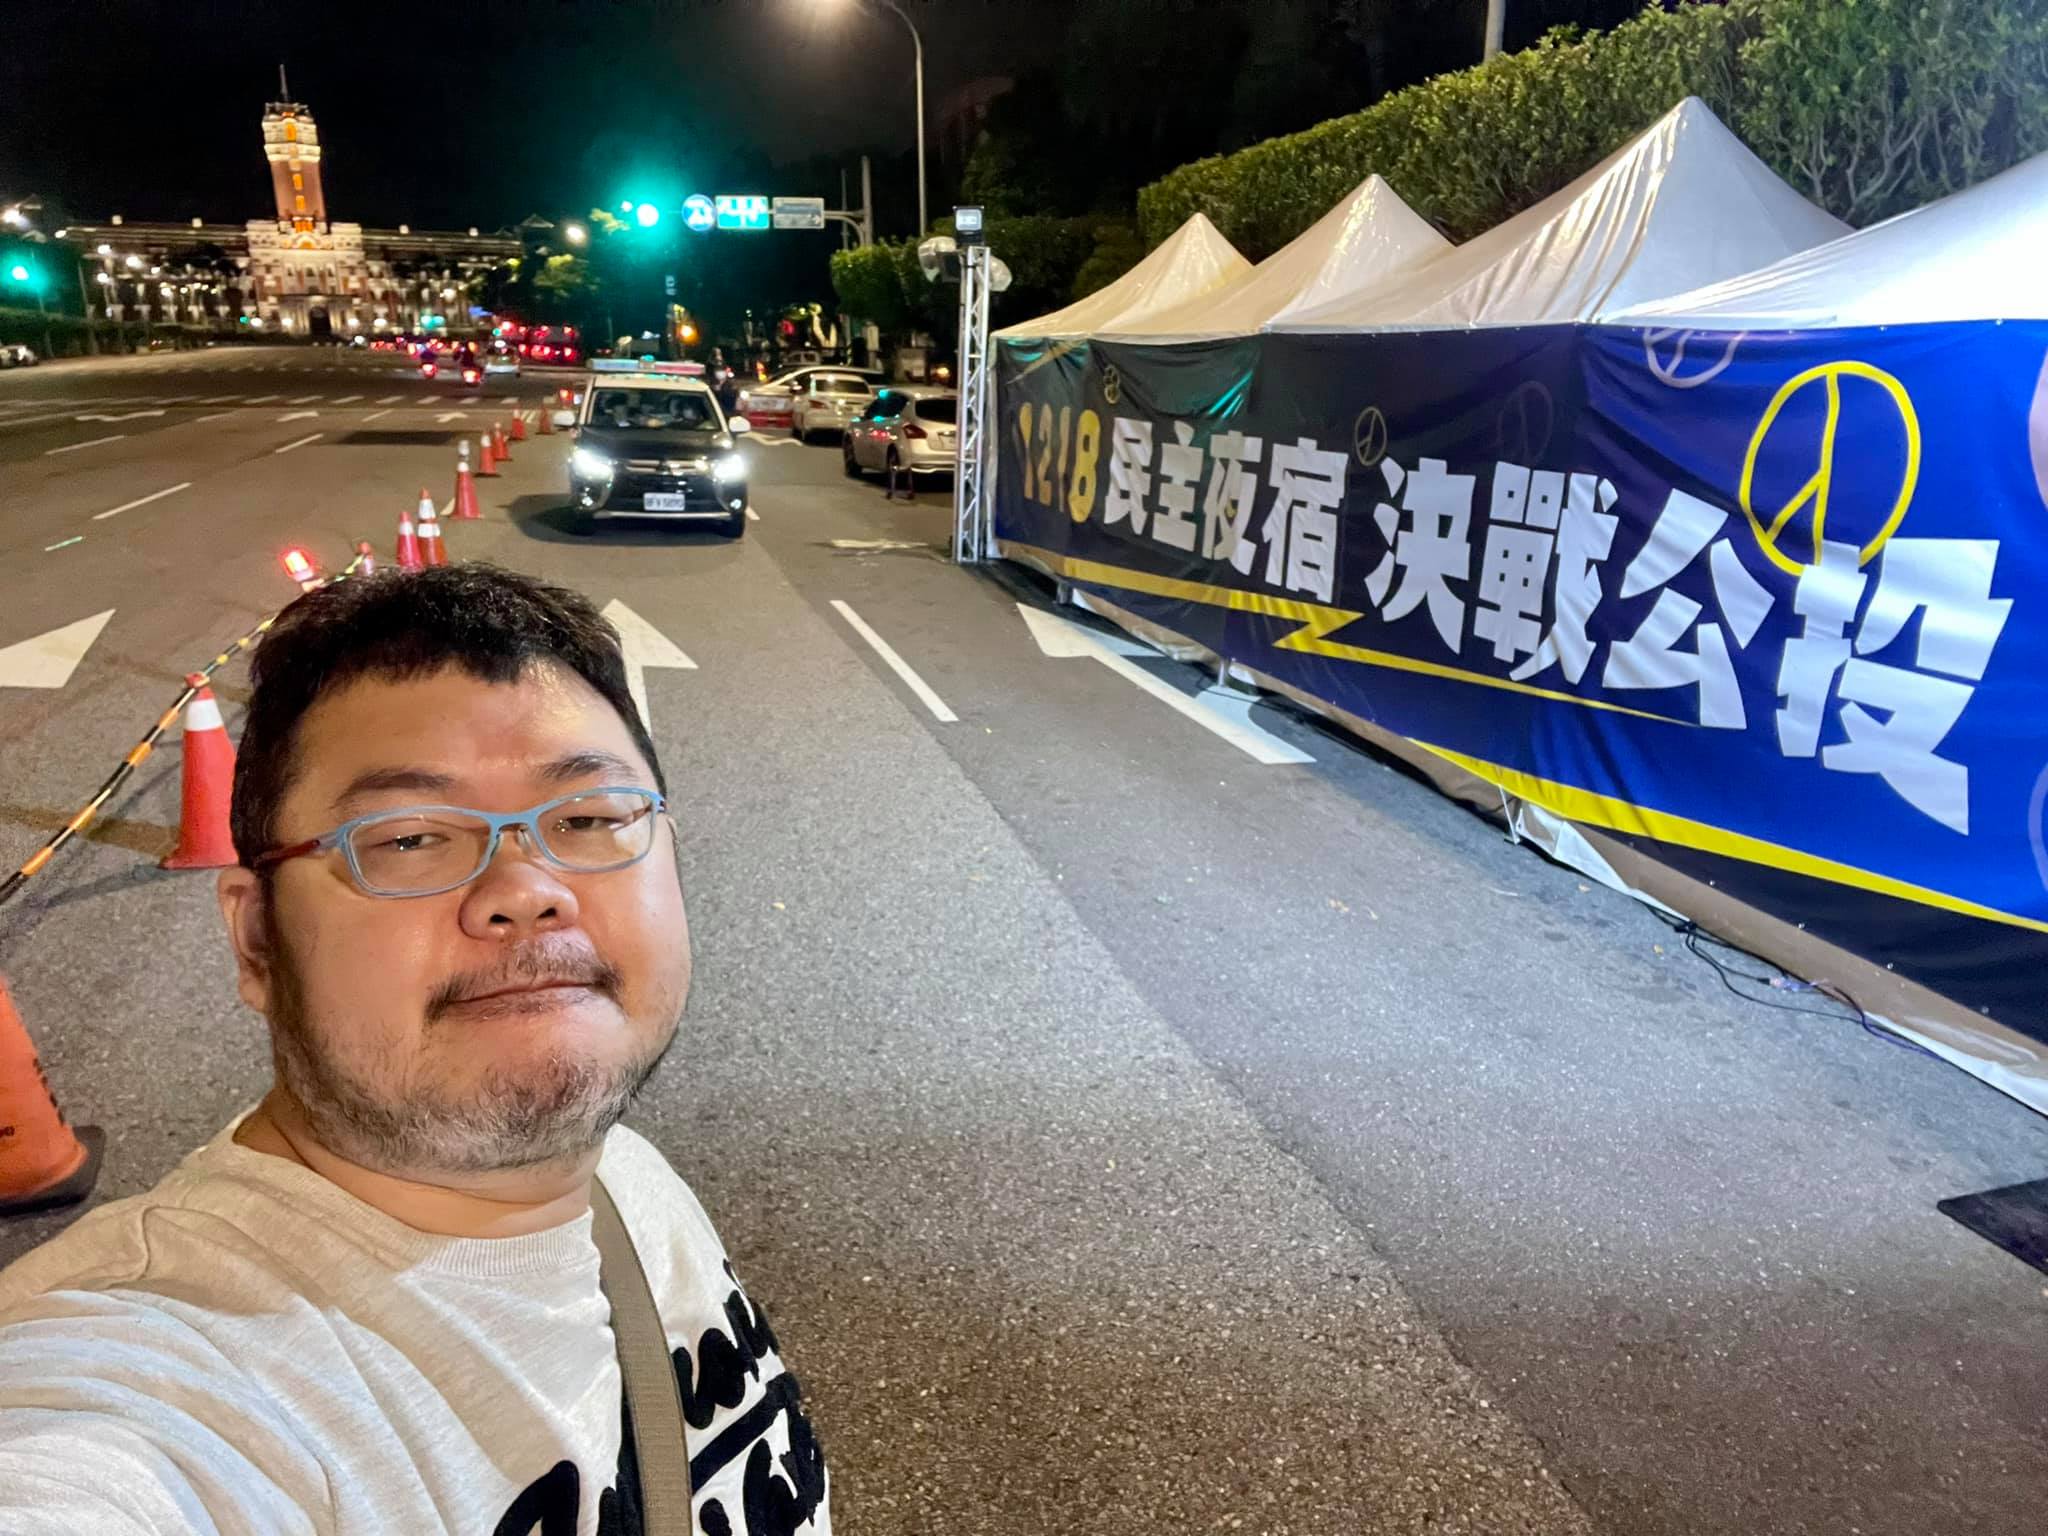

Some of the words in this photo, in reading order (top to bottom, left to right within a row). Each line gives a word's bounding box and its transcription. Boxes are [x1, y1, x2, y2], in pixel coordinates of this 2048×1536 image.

[1018, 401, 1101, 523] 1218
[1103, 416, 1349, 603] 民主夜宿
[1364, 457, 2014, 835] 決戰公投
